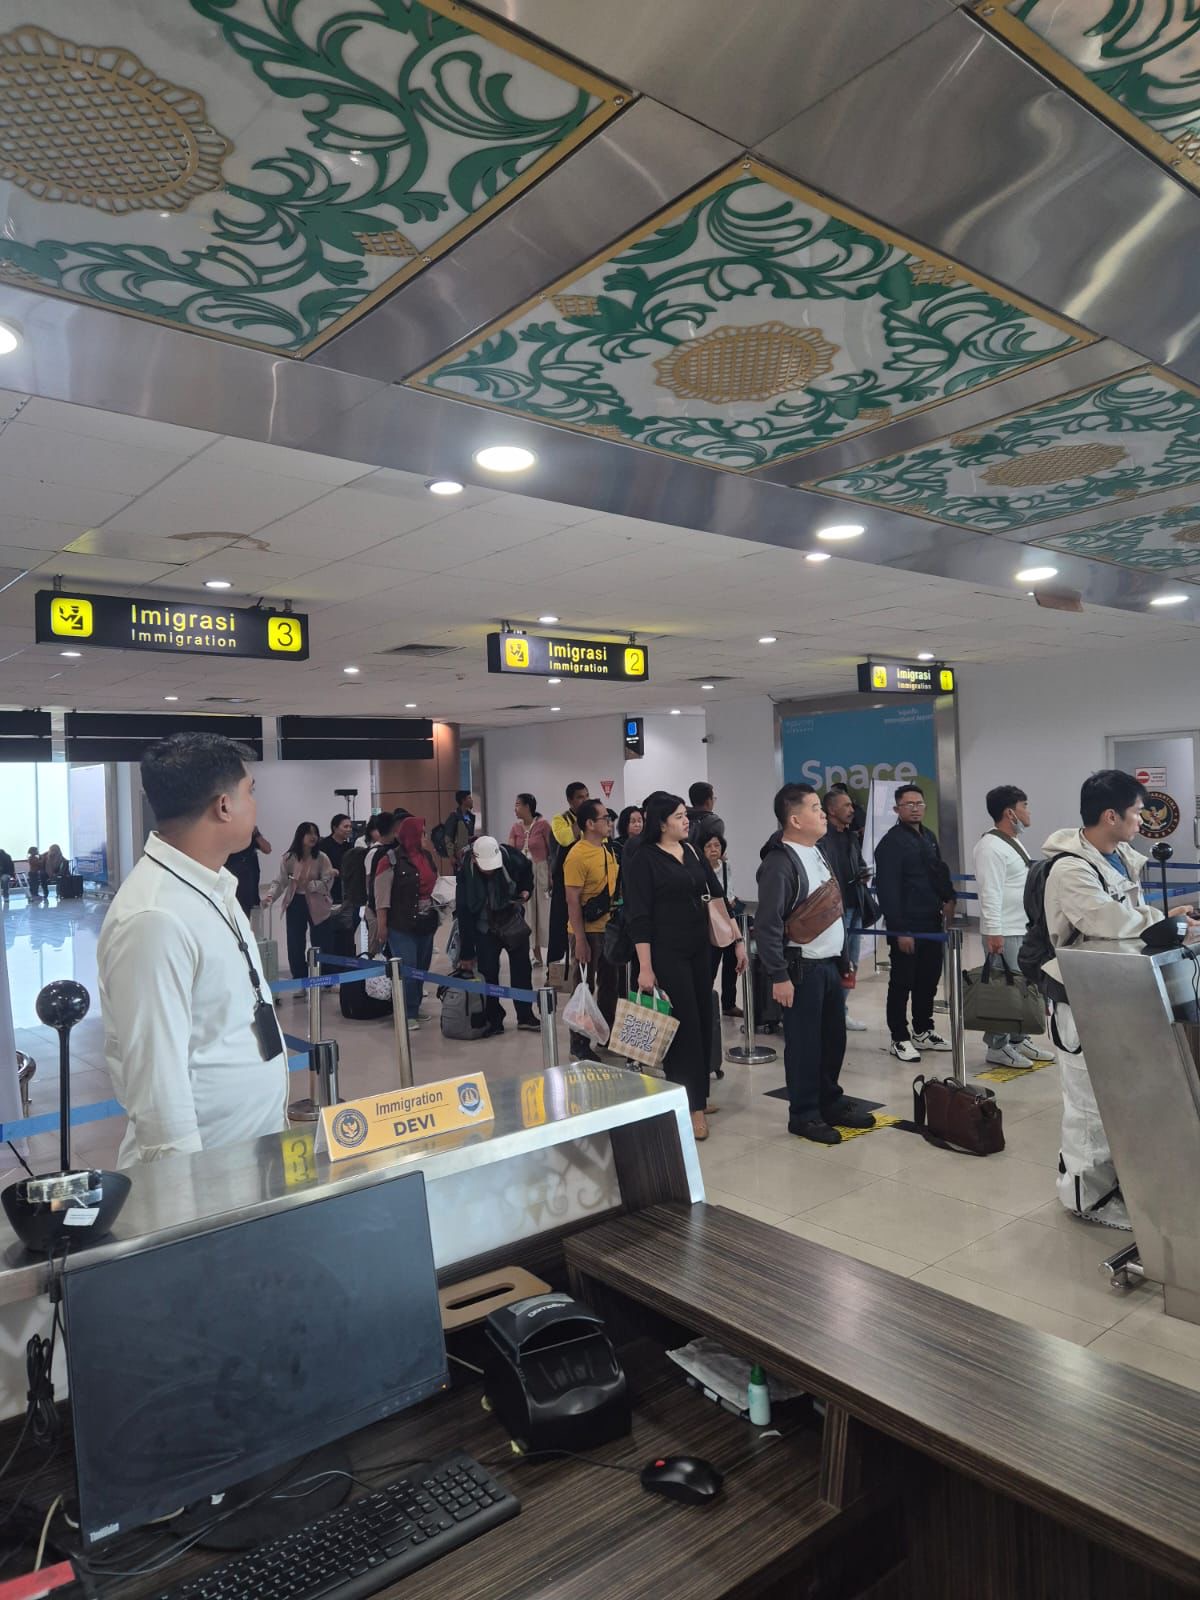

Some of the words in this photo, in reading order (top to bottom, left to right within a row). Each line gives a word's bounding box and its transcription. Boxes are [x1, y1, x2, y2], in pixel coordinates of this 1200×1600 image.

[131, 604, 236, 632] Imigrasi
[131, 628, 237, 648] Immigration
[277, 622, 293, 647] 3
[549, 641, 608, 662] Imigrasi
[630, 652, 640, 672] 2
[550, 660, 609, 674] Immigration
[896, 667, 931, 682] Imigrasi
[801, 759, 918, 790] Space
[375, 1090, 444, 1117] Immigration
[393, 1113, 437, 1137] DEVI
